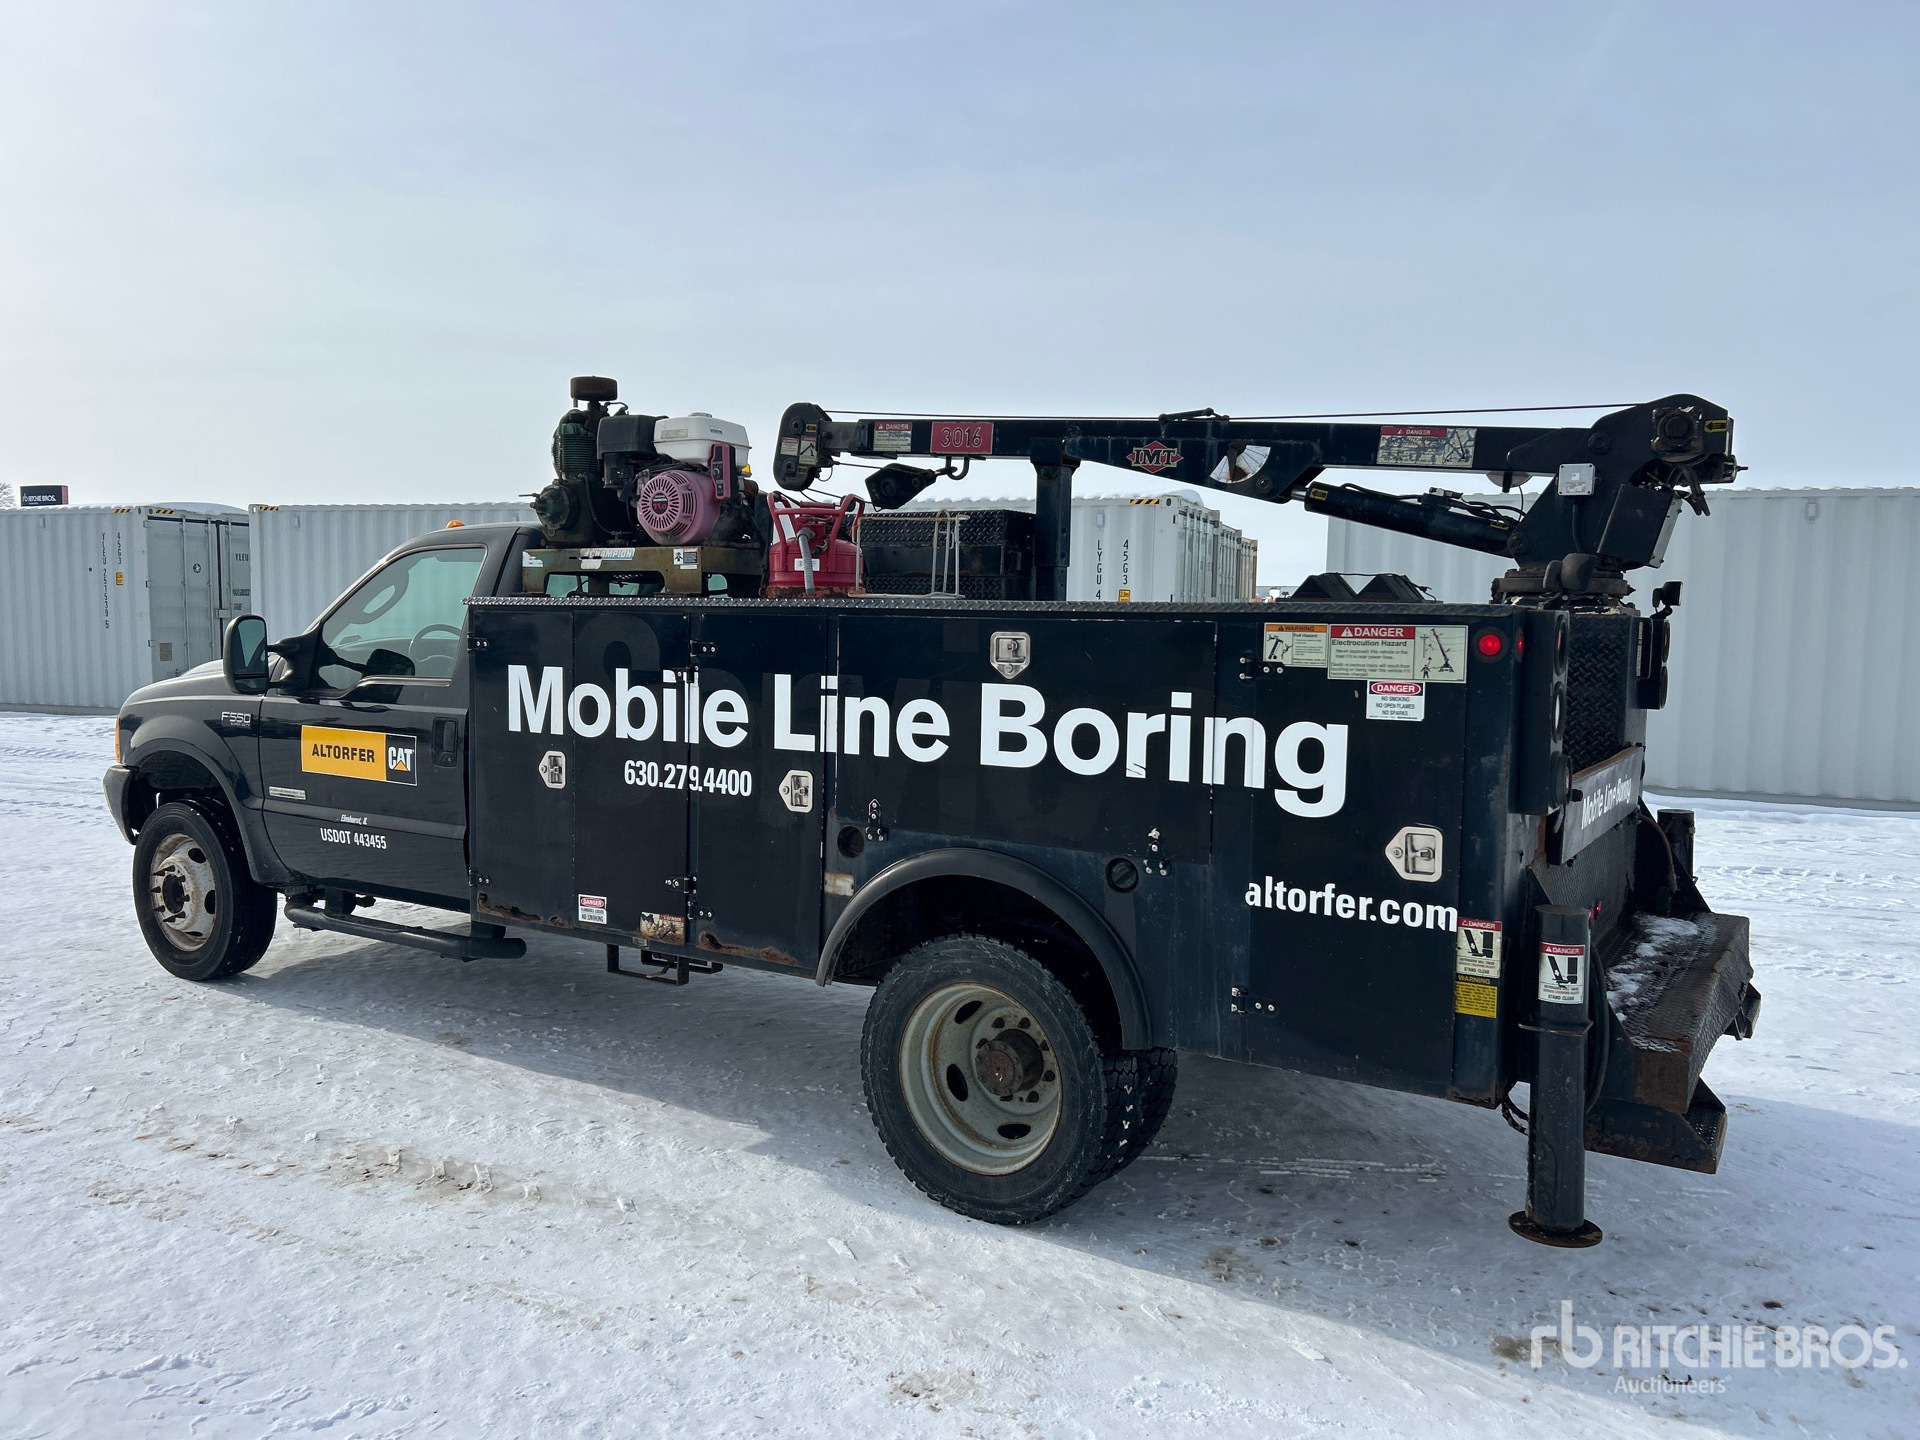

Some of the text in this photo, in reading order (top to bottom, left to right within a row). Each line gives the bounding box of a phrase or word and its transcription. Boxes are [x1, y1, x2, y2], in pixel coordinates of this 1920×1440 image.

[941, 426, 983, 447] 3016
[1131, 447, 1177, 467] IMT
[589, 547, 632, 559] CHAMPION
[1354, 627, 1404, 637] DANGER
[1377, 685, 1415, 693] DANGER
[221, 711, 252, 723] F550
[507, 665, 1349, 818] Mobile Line Boring
[312, 743, 375, 763] ALTORFER
[388, 746, 413, 771] CAT
[624, 759, 752, 797] 630.279.4400
[1582, 788, 1604, 830] Mobile
[1604, 783, 1617, 813] Line
[320, 827, 387, 850] USDOT 443455
[1244, 875, 1458, 933] altorfer.com
[1468, 921, 1496, 929] DANGER
[1458, 975, 1491, 985] WARNING
